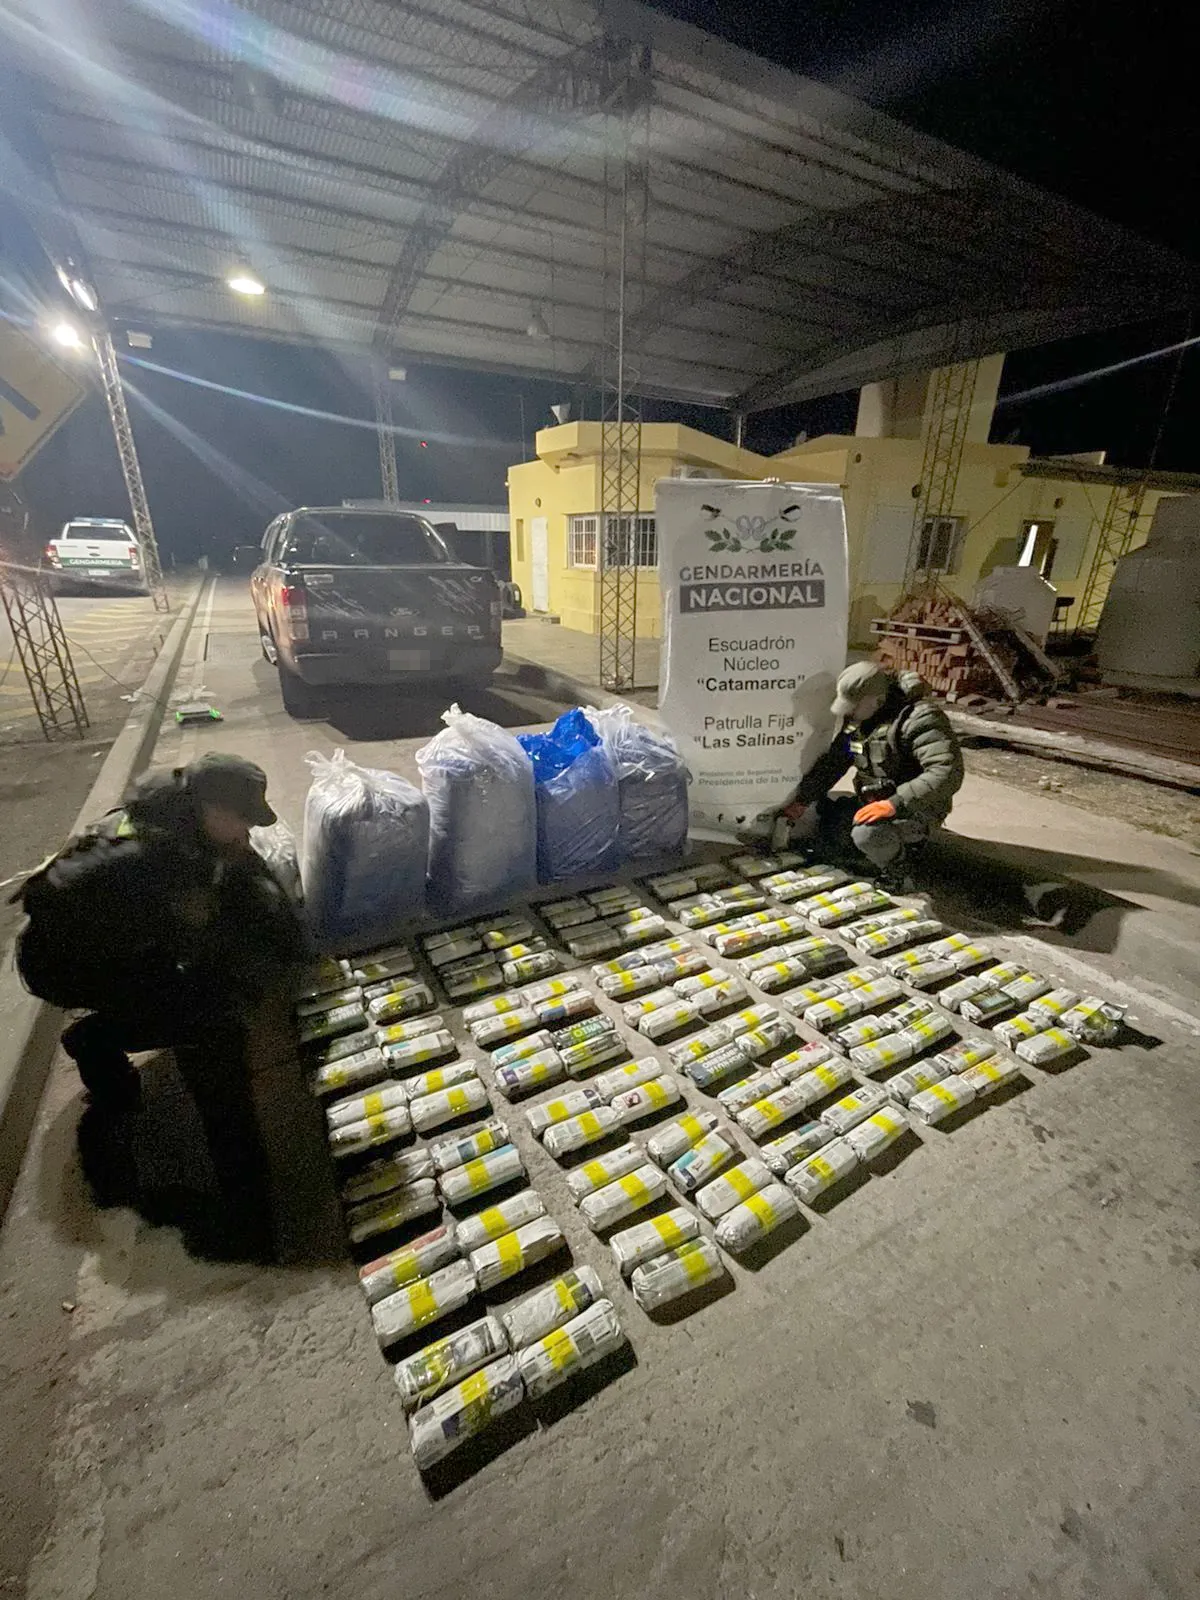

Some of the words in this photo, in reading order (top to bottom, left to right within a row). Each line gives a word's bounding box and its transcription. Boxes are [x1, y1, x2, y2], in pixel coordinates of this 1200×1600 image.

[679, 558, 825, 582] GENDARMERÍA
[689, 585, 819, 608] NACIONAL
[322, 625, 481, 640] RANGER
[708, 636, 796, 652] Escuadrón
[723, 656, 780, 672] Núcleo
[704, 715, 762, 730] Patrulla
[768, 714, 795, 731] Fija
[698, 778, 754, 786] Presidencia
[756, 776, 769, 785] de
[771, 775, 779, 783] la
